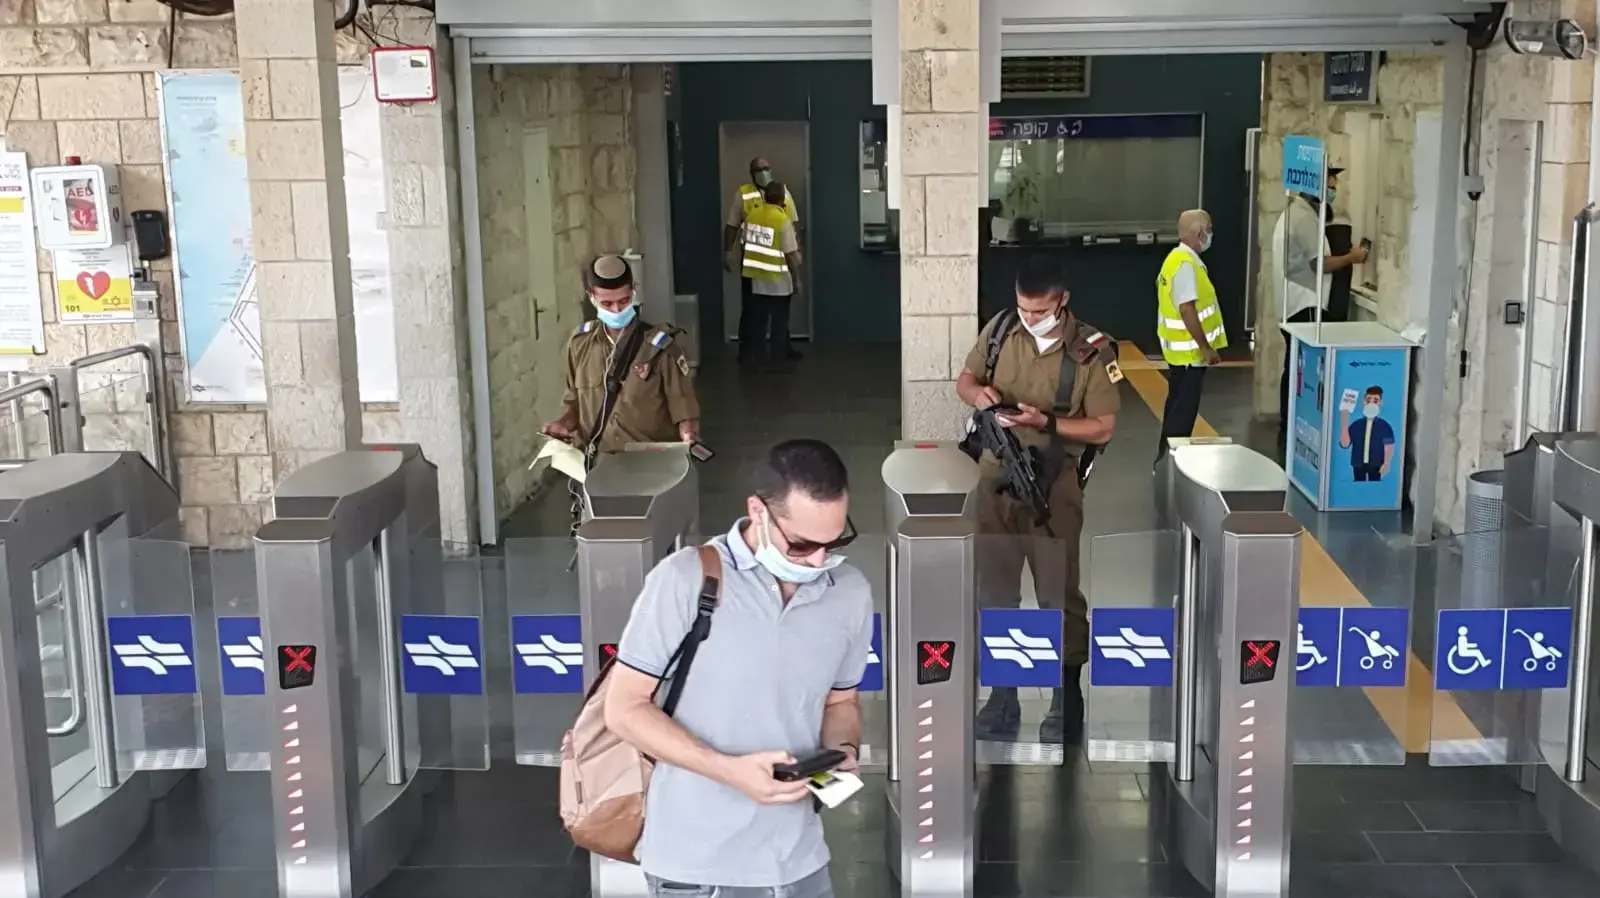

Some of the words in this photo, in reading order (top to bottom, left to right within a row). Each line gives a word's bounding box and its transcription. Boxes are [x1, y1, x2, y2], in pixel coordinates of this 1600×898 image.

[1013, 121, 1048, 137] קופה
[68, 186, 93, 198] AED
[65, 304, 80, 312] 101
